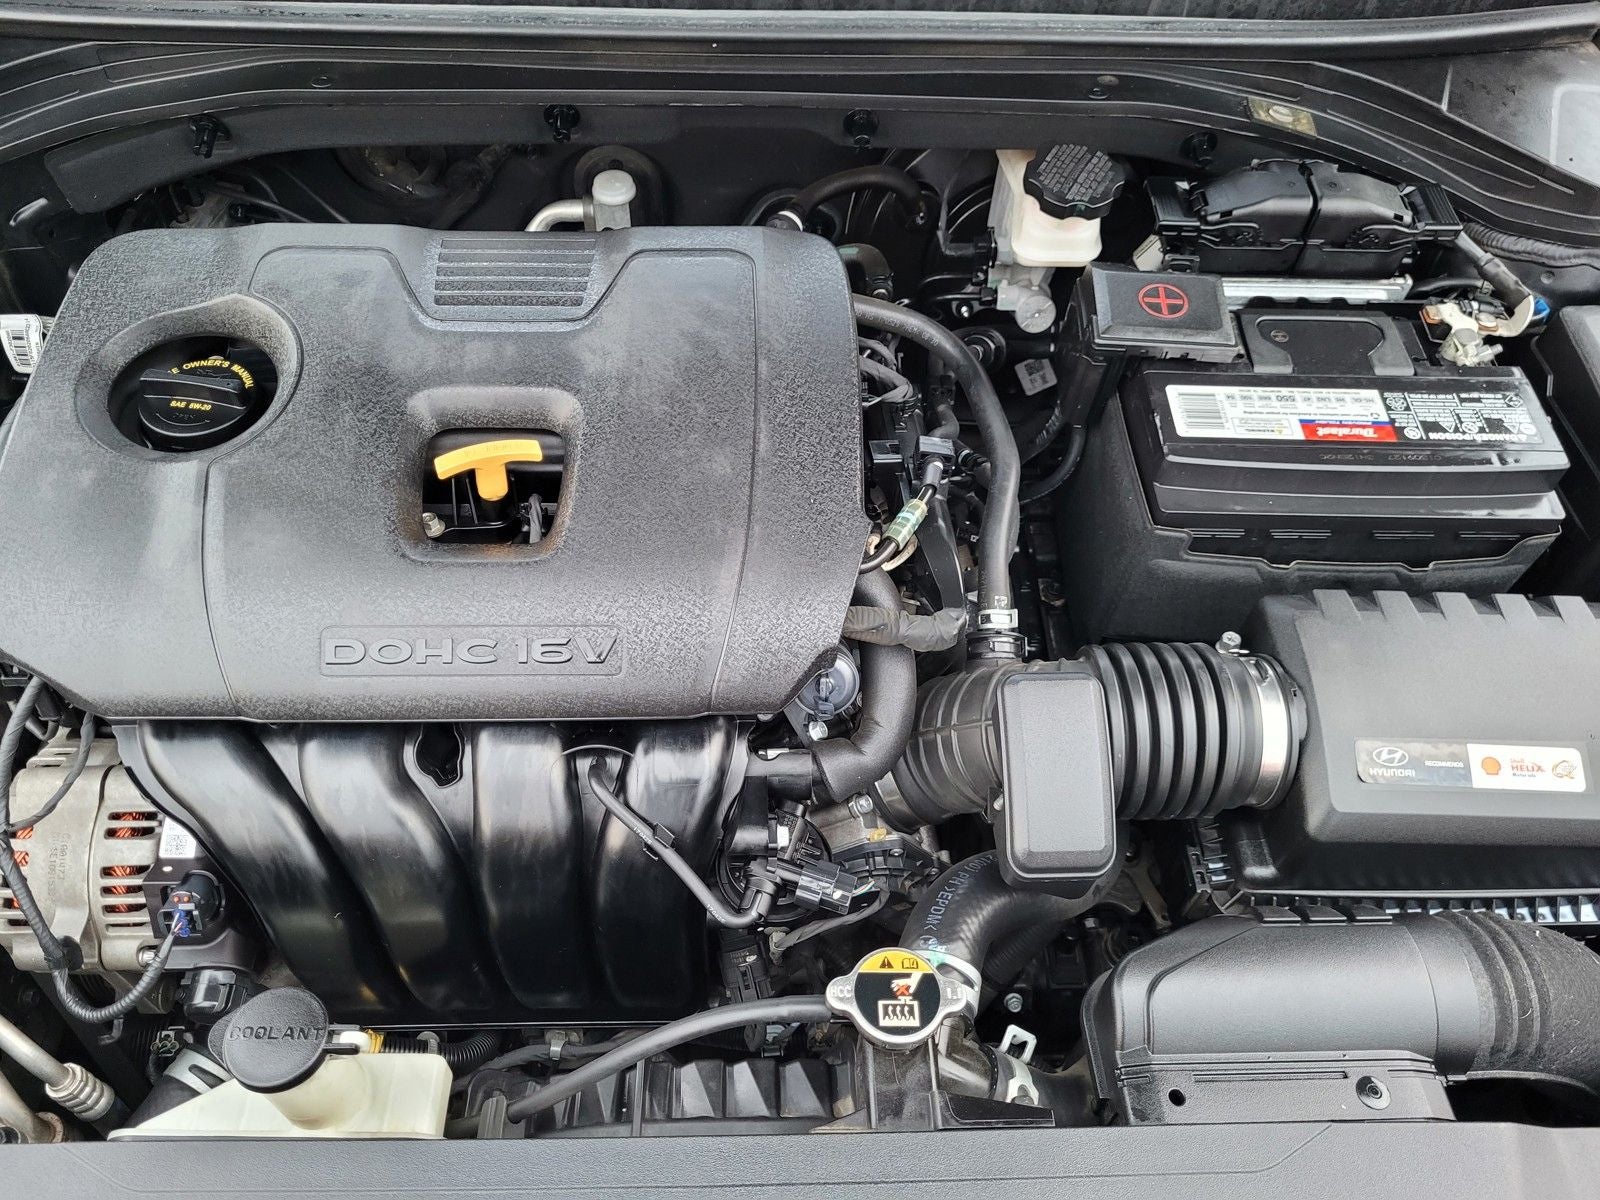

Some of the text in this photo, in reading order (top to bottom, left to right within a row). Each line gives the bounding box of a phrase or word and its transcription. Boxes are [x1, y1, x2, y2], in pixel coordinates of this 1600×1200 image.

[182, 358, 231, 370] OWNER'S
[230, 364, 255, 389] MANUAL
[169, 400, 212, 411] SAE 5W-20
[1316, 427, 1378, 438] Duralast
[325, 637, 617, 665] DOHC 16V
[1424, 760, 1464, 768] RECOMMENDS
[1510, 763, 1546, 773] HELIX
[1369, 767, 1415, 777] HYUNDAI
[829, 985, 852, 998] HCC
[229, 1025, 323, 1041] COOLANT
